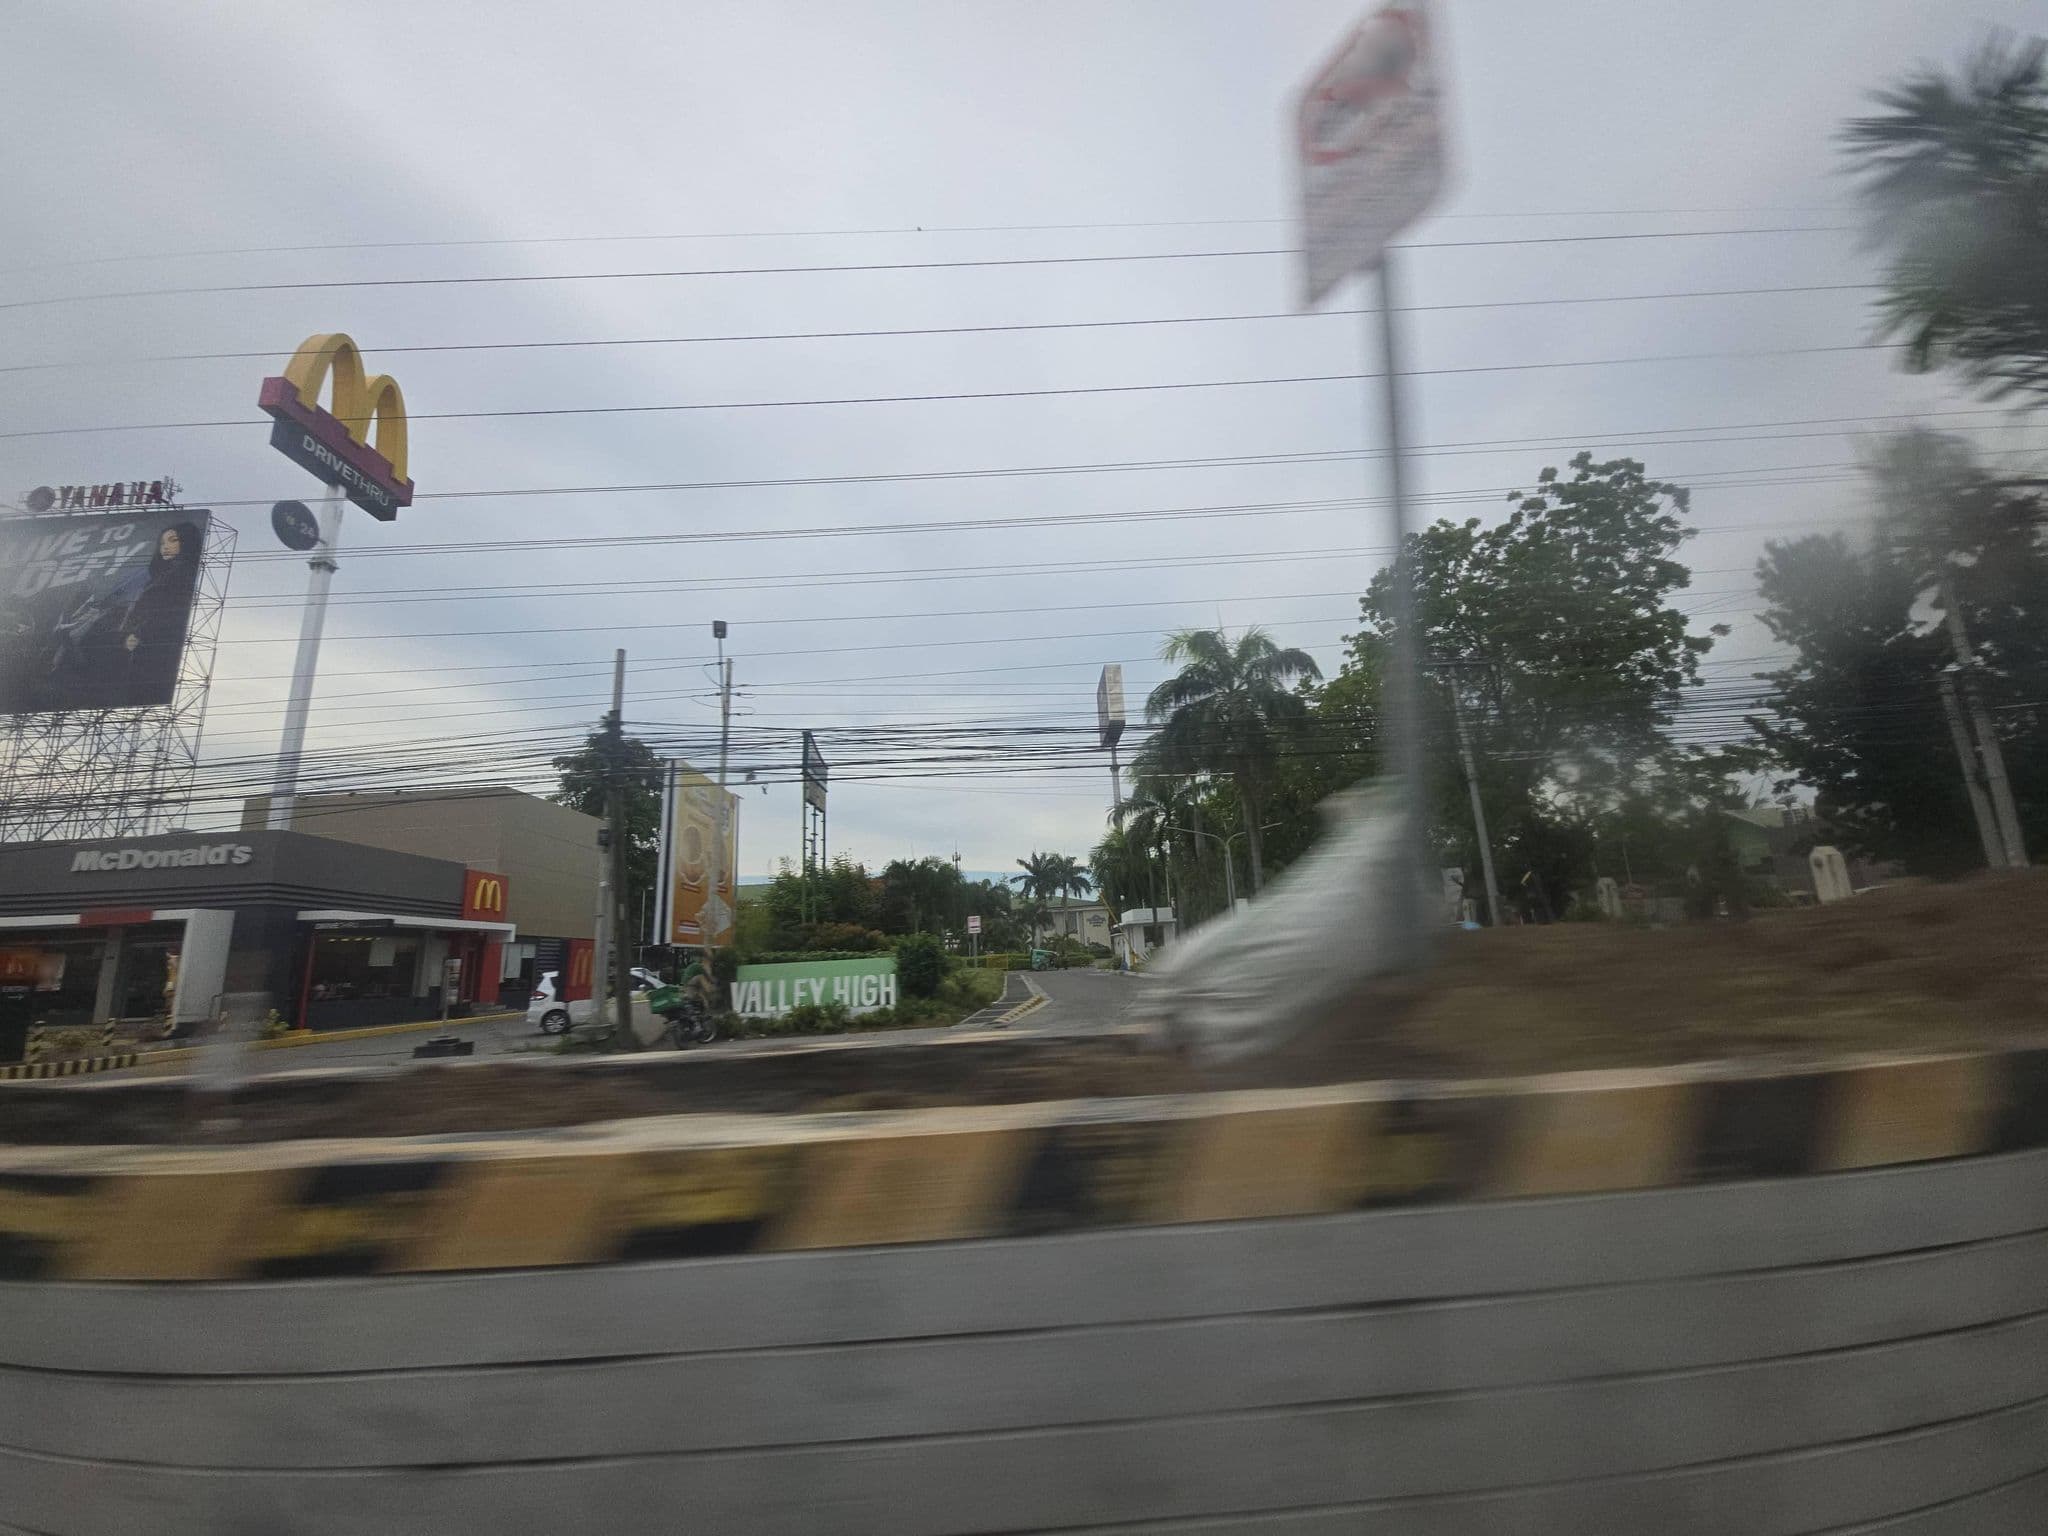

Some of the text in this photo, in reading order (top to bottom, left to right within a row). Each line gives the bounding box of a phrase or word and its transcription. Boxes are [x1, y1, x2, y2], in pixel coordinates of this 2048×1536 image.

[59, 480, 166, 510] YAMAHA
[99, 523, 137, 545] TO
[70, 843, 253, 872] McDonald's
[729, 973, 897, 1013] VALLEY HIGH
